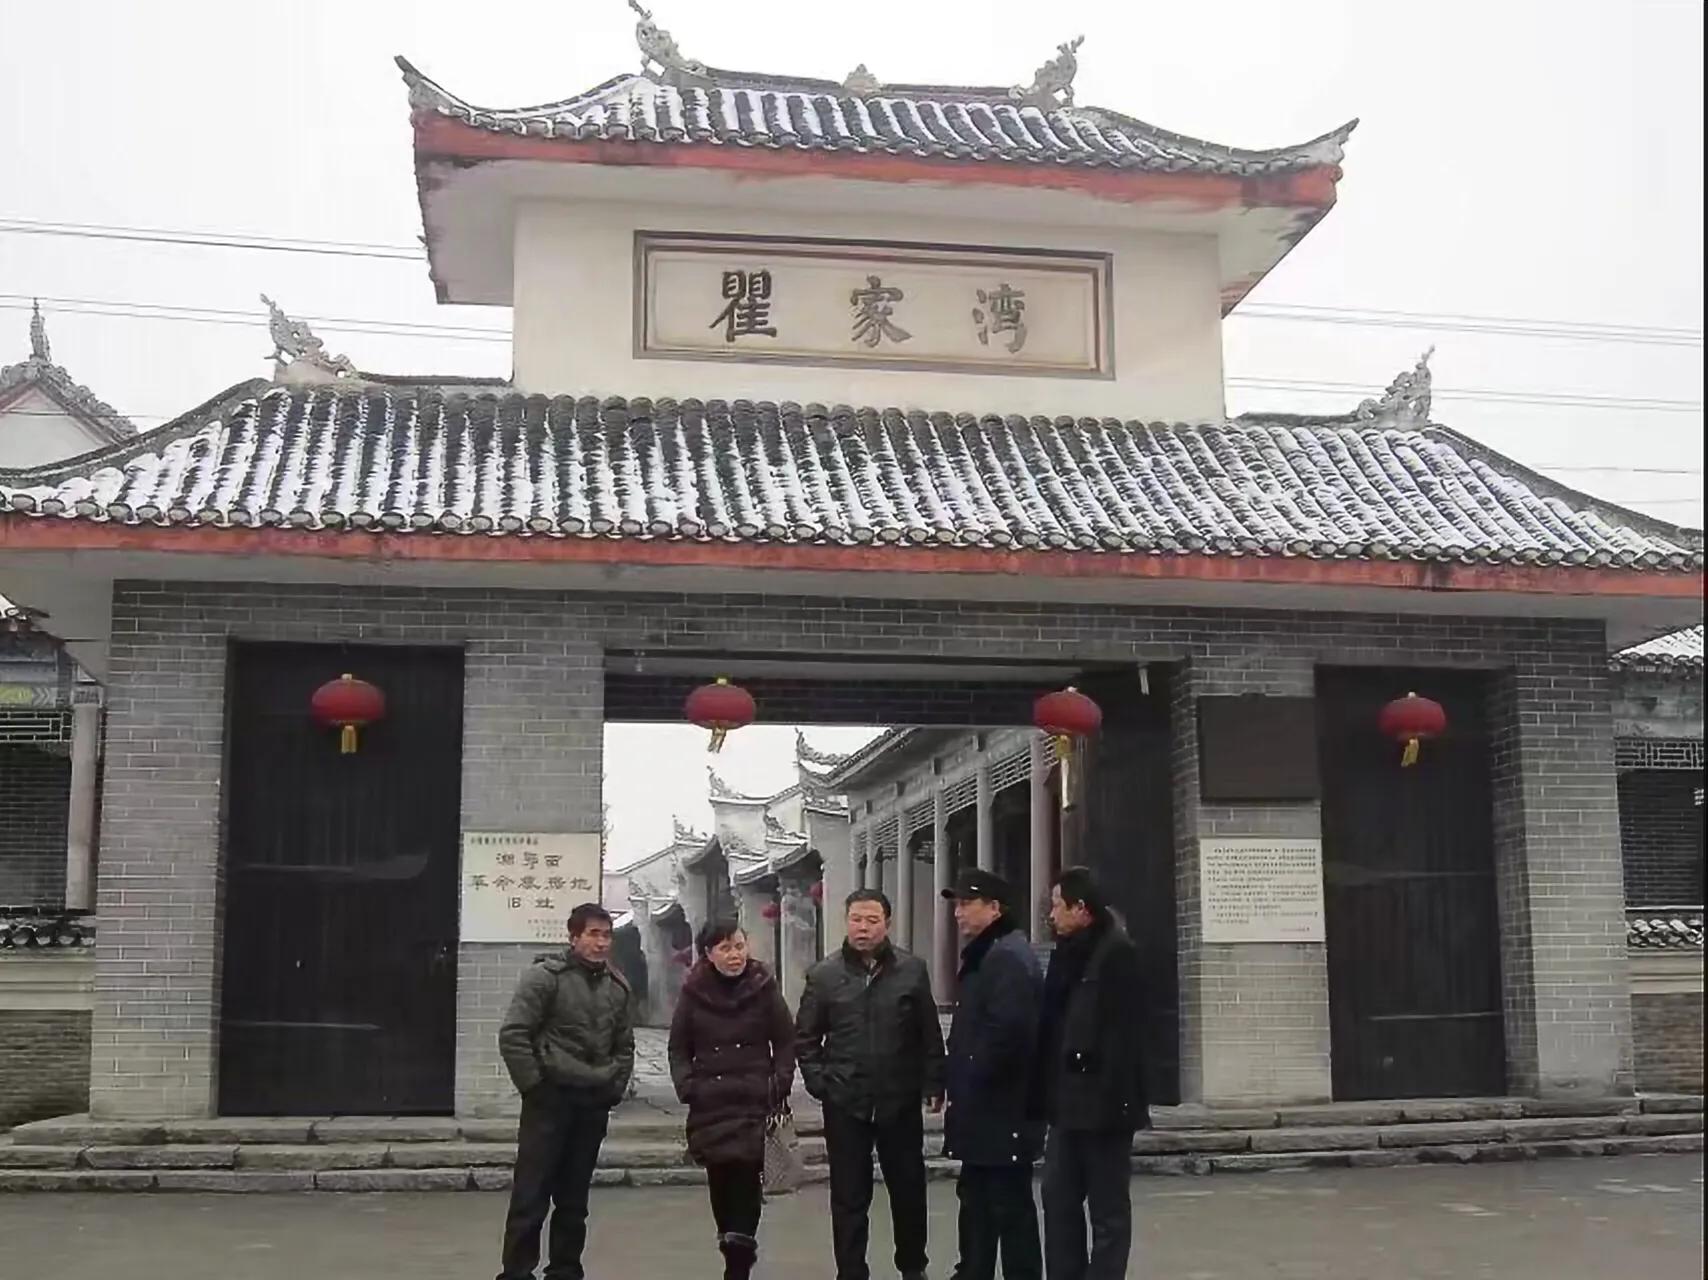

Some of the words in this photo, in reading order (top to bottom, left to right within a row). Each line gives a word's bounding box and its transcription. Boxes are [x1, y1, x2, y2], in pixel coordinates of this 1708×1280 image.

[710, 269, 1027, 353] 瞿家湾
[508, 897, 554, 909] 旧址
